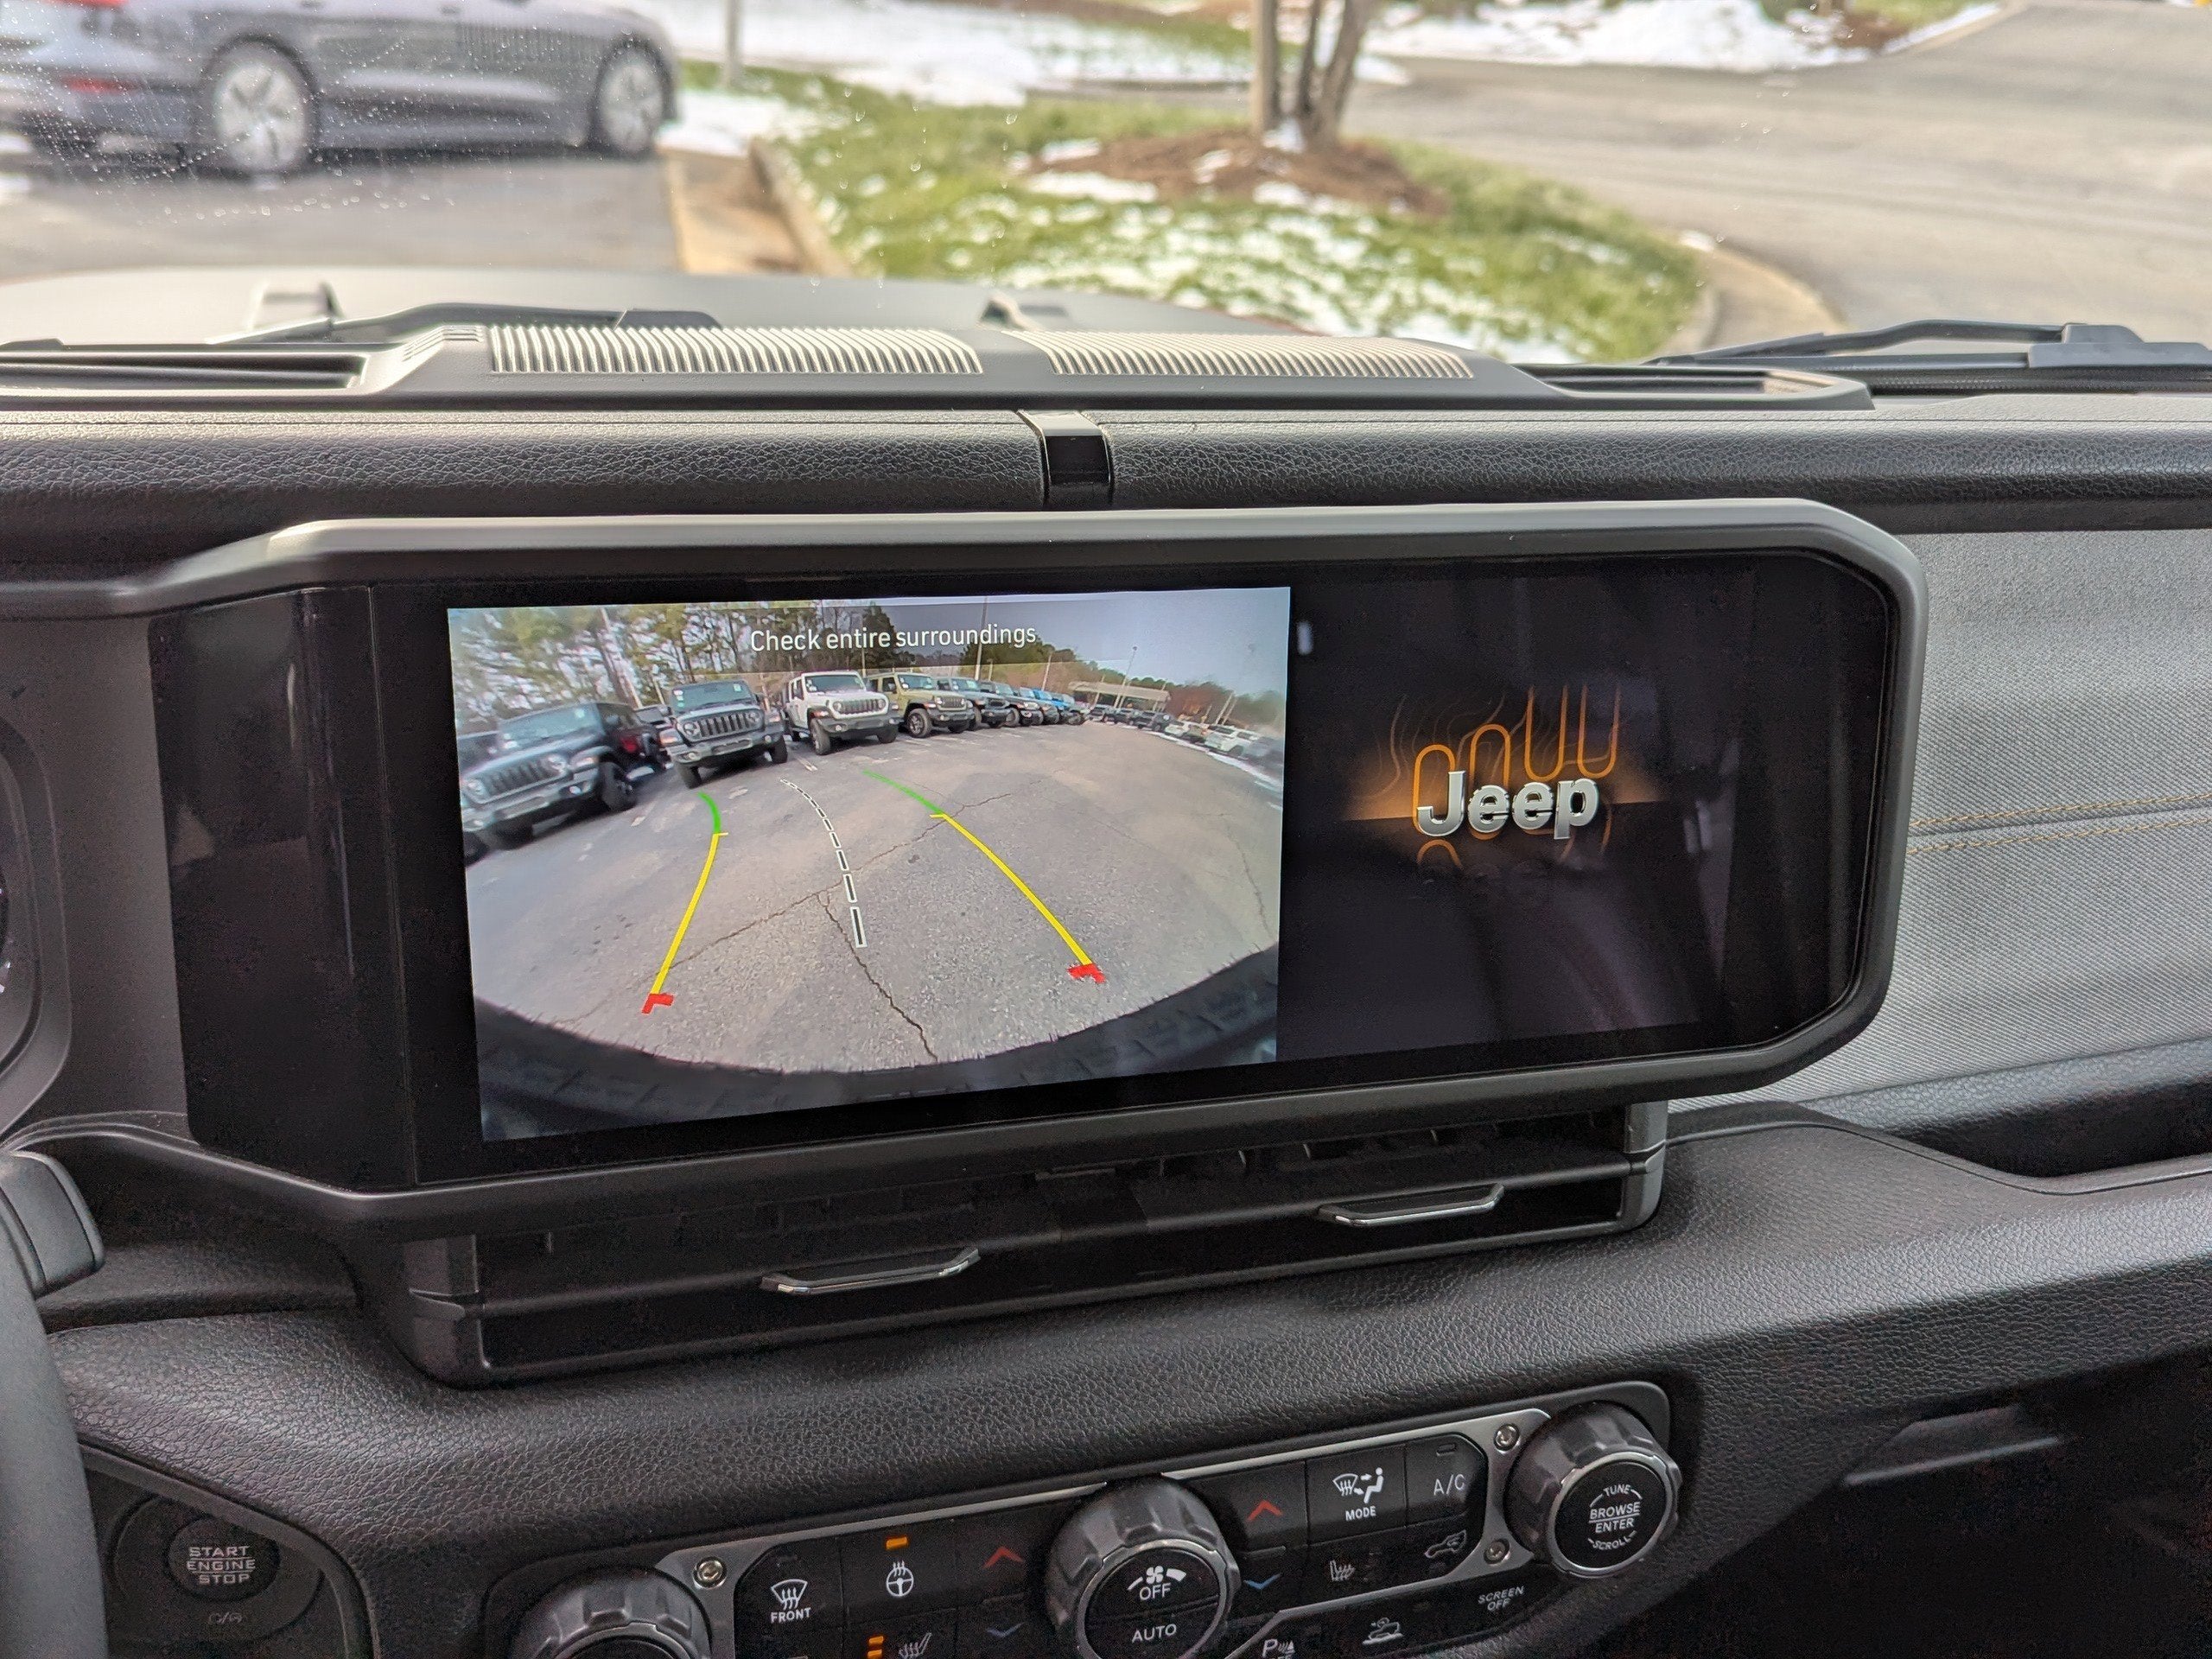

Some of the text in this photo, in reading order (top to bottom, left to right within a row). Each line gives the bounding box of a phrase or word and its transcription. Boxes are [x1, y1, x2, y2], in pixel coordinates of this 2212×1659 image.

[750, 623, 1037, 652] Check entire surroundings
[1416, 770, 1599, 840] Jeep
[1433, 1474, 1465, 1496] A/C
[1603, 1484, 1631, 1497] TUNE
[1345, 1506, 1376, 1521] MODE
[1590, 1502, 1641, 1519] BROWSE
[1595, 1517, 1635, 1533] ENTER
[189, 1545, 250, 1557] START
[1592, 1535, 1631, 1551] SCROLL
[186, 1559, 256, 1571] ENGINE
[199, 1573, 251, 1585] STOP
[1139, 1582, 1172, 1600] OFF
[1478, 1586, 1525, 1605] SCREEN
[1487, 1598, 1511, 1611] OFF
[770, 1607, 811, 1624] FRONT
[1132, 1624, 1177, 1643] AUTO
